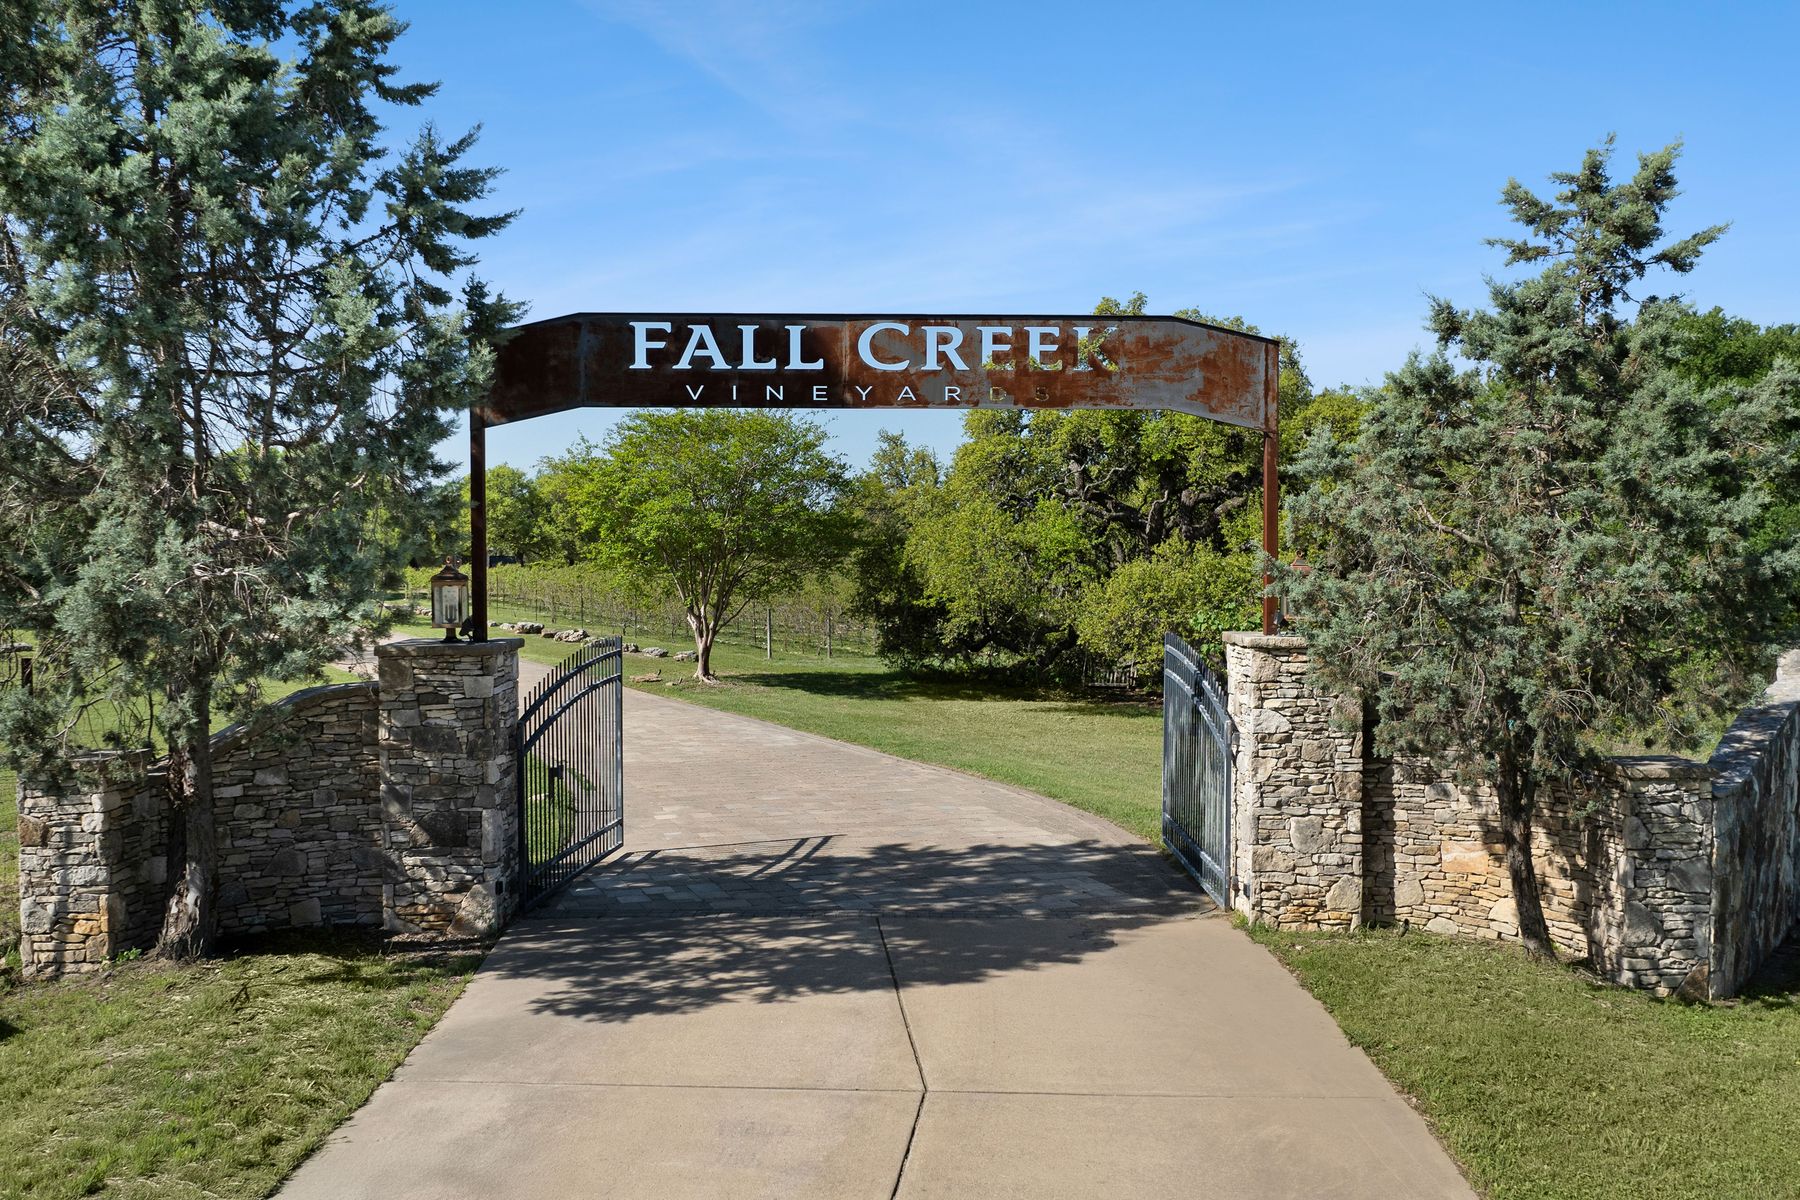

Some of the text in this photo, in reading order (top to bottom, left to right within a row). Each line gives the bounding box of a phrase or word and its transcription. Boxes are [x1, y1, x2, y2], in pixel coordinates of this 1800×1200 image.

[629, 321, 1120, 372] FALL CREEK
[685, 384, 1050, 401] VINEYARDS
